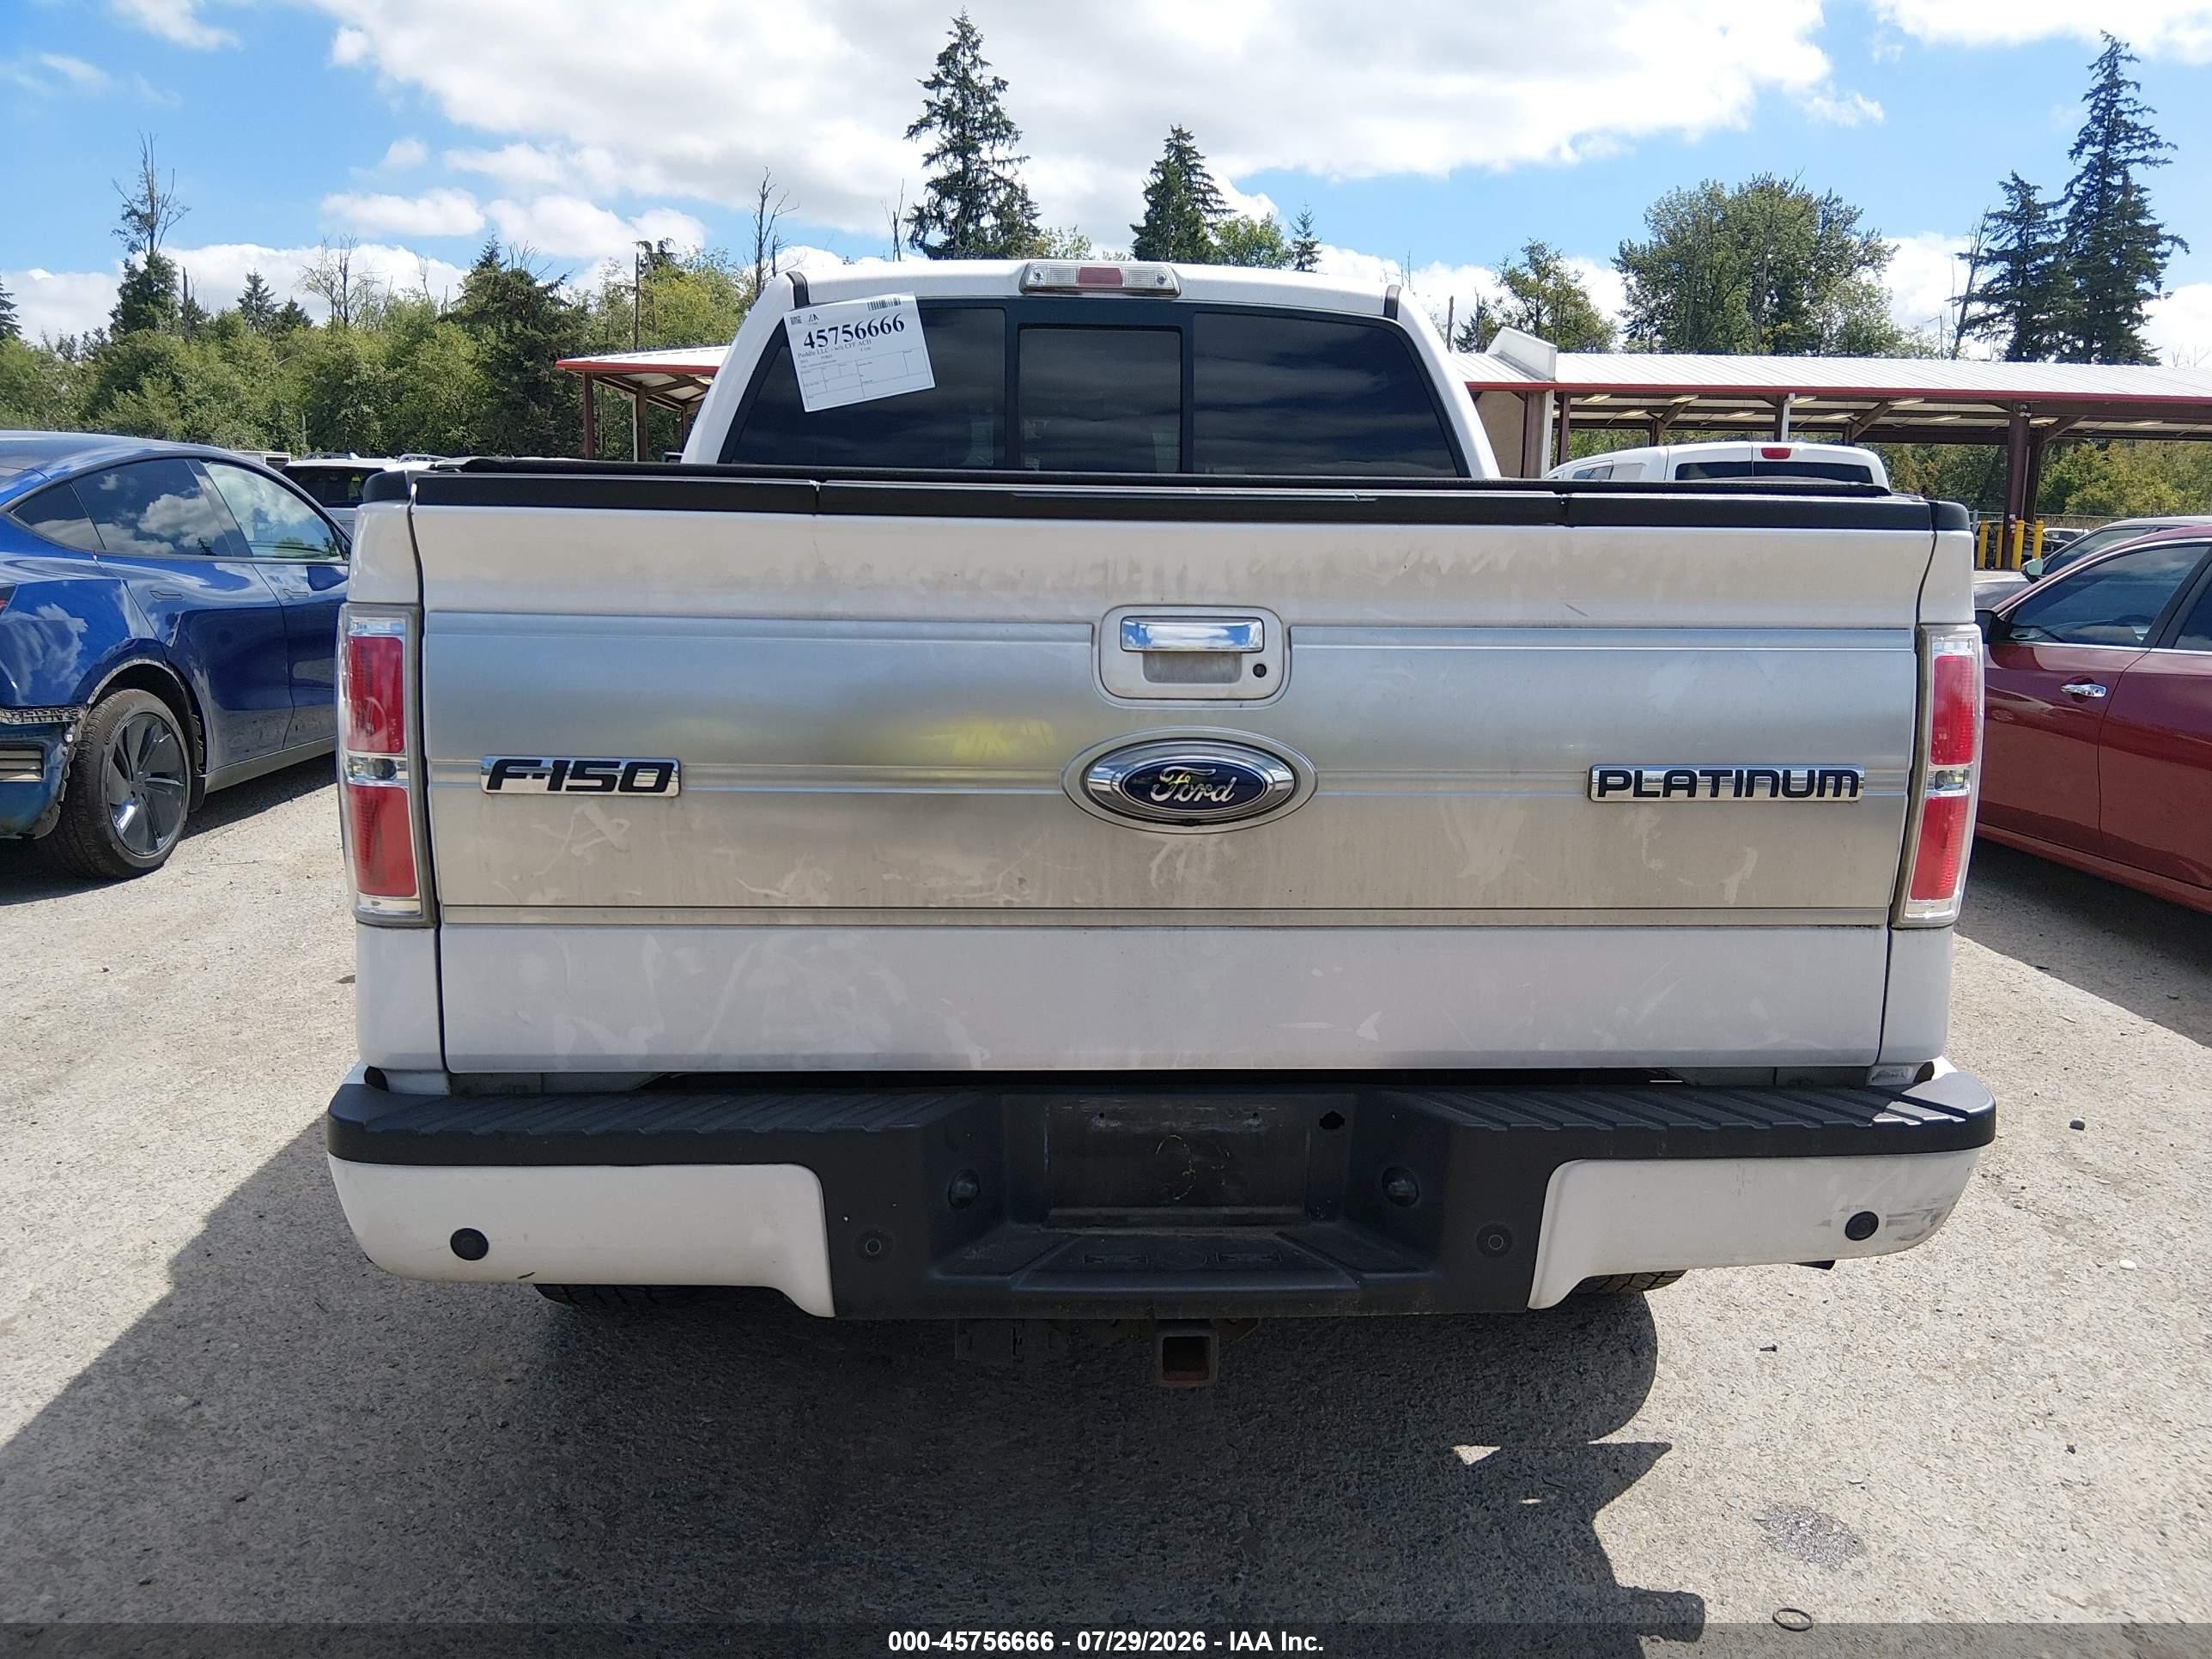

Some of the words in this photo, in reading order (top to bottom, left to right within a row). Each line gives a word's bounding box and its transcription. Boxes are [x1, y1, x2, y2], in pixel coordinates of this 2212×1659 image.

[804, 313, 905, 349] 45756666
[486, 758, 676, 793] F-150
[1150, 765, 1237, 803] Ford
[1596, 769, 1860, 799] PLATINUM
